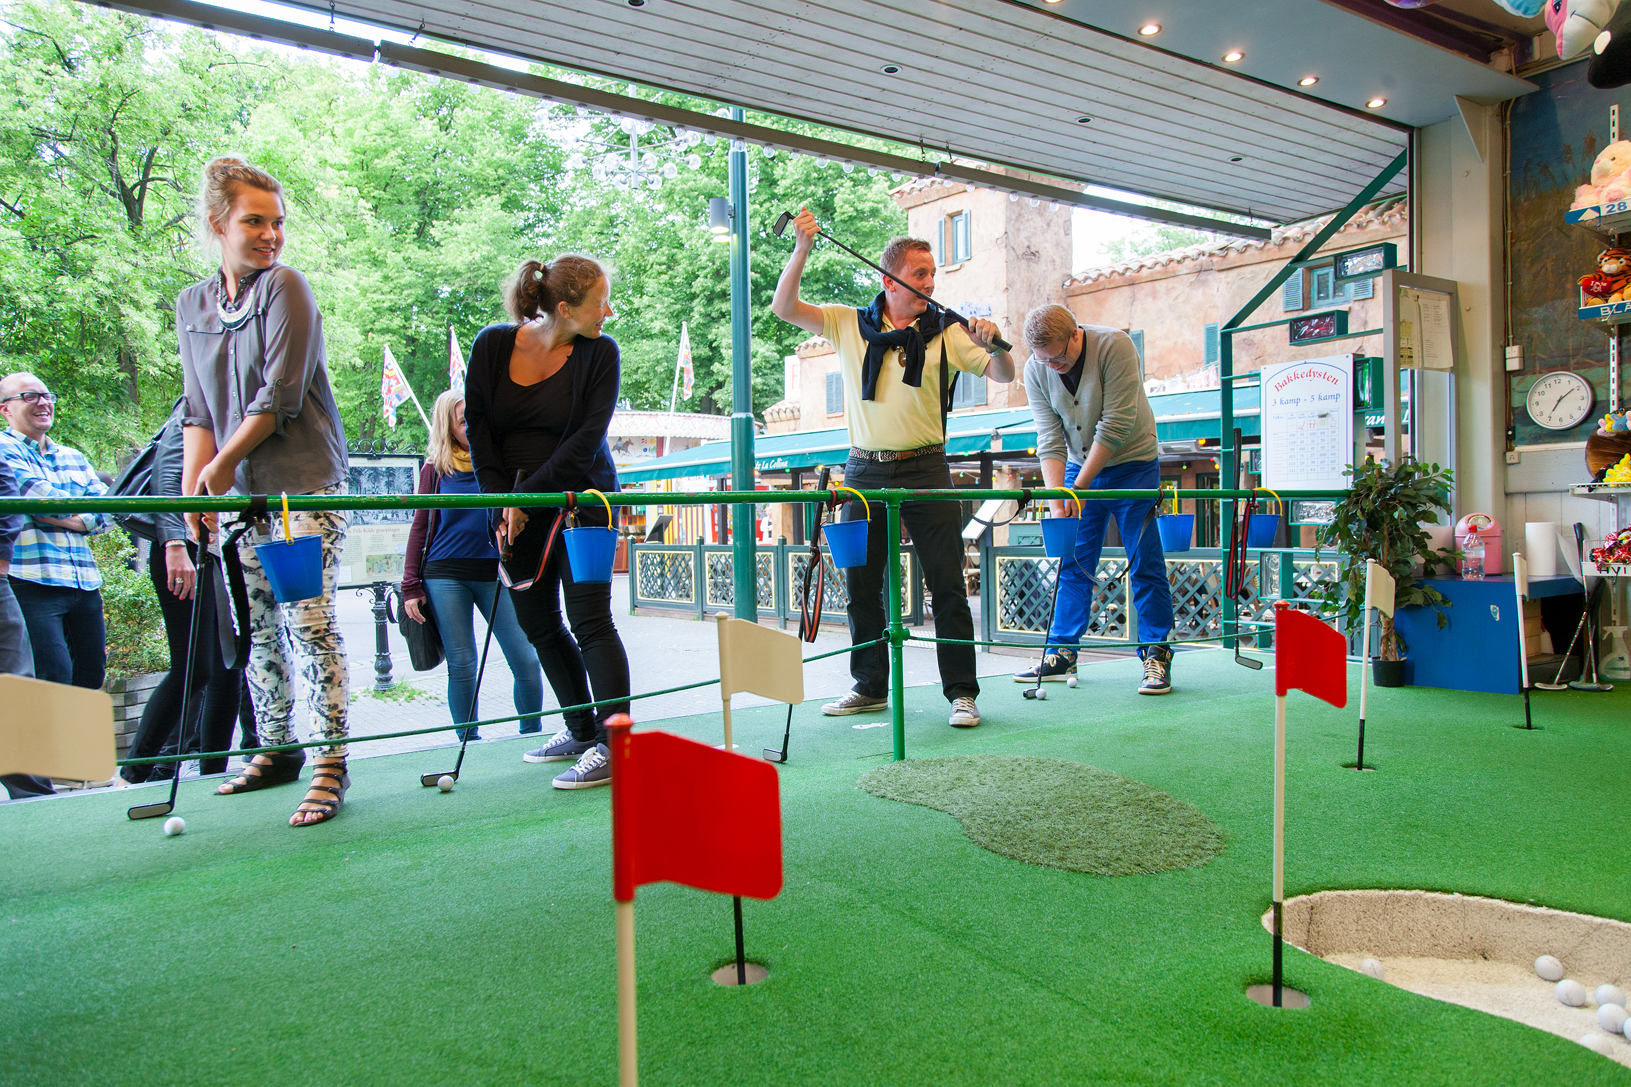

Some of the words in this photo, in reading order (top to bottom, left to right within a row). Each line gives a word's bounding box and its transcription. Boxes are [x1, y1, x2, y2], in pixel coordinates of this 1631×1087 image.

[1605, 202, 1628, 214] 28
[1274, 367, 1339, 392] Bakkedysten
[1280, 397, 1301, 406] kamp
[1318, 393, 1340, 403] kamp
